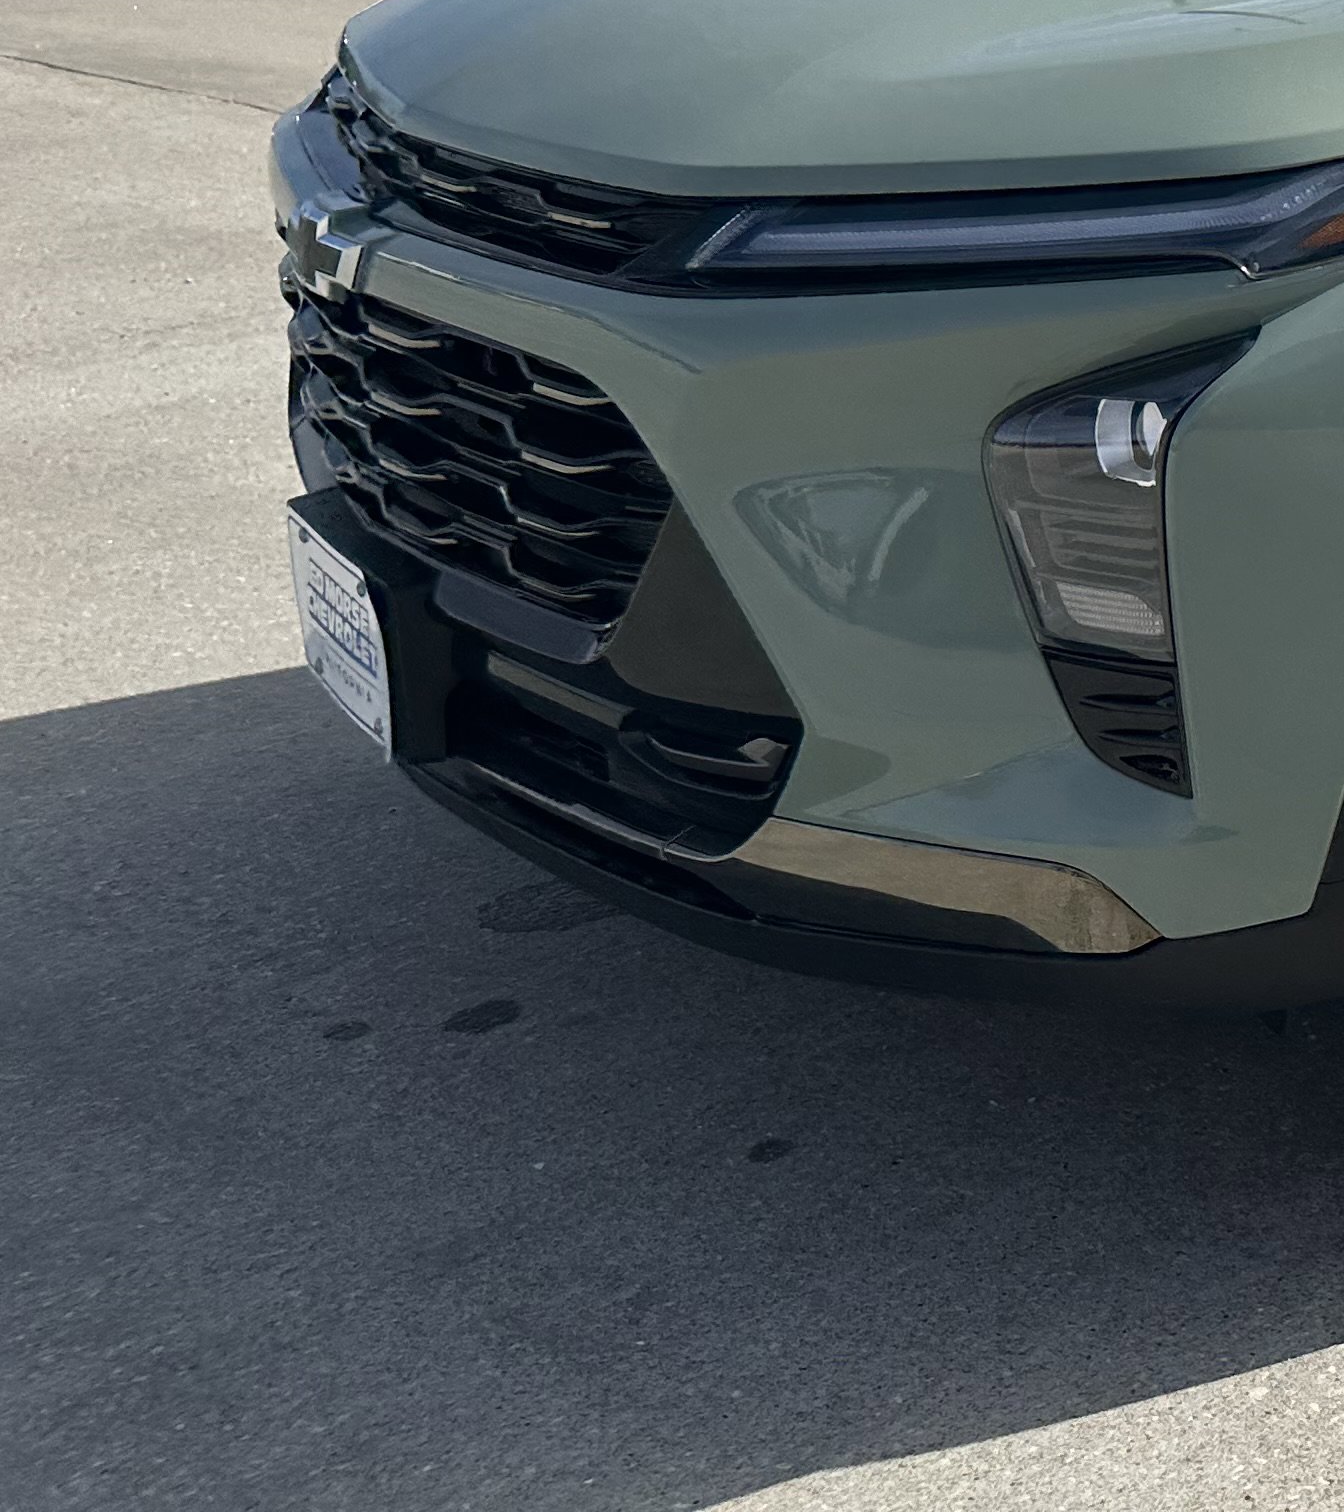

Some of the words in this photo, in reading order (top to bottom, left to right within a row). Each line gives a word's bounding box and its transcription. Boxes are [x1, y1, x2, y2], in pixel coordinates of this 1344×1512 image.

[308, 590, 378, 676] CHEVROLET
[309, 563, 324, 595] ED
[324, 575, 370, 637] MORSE
